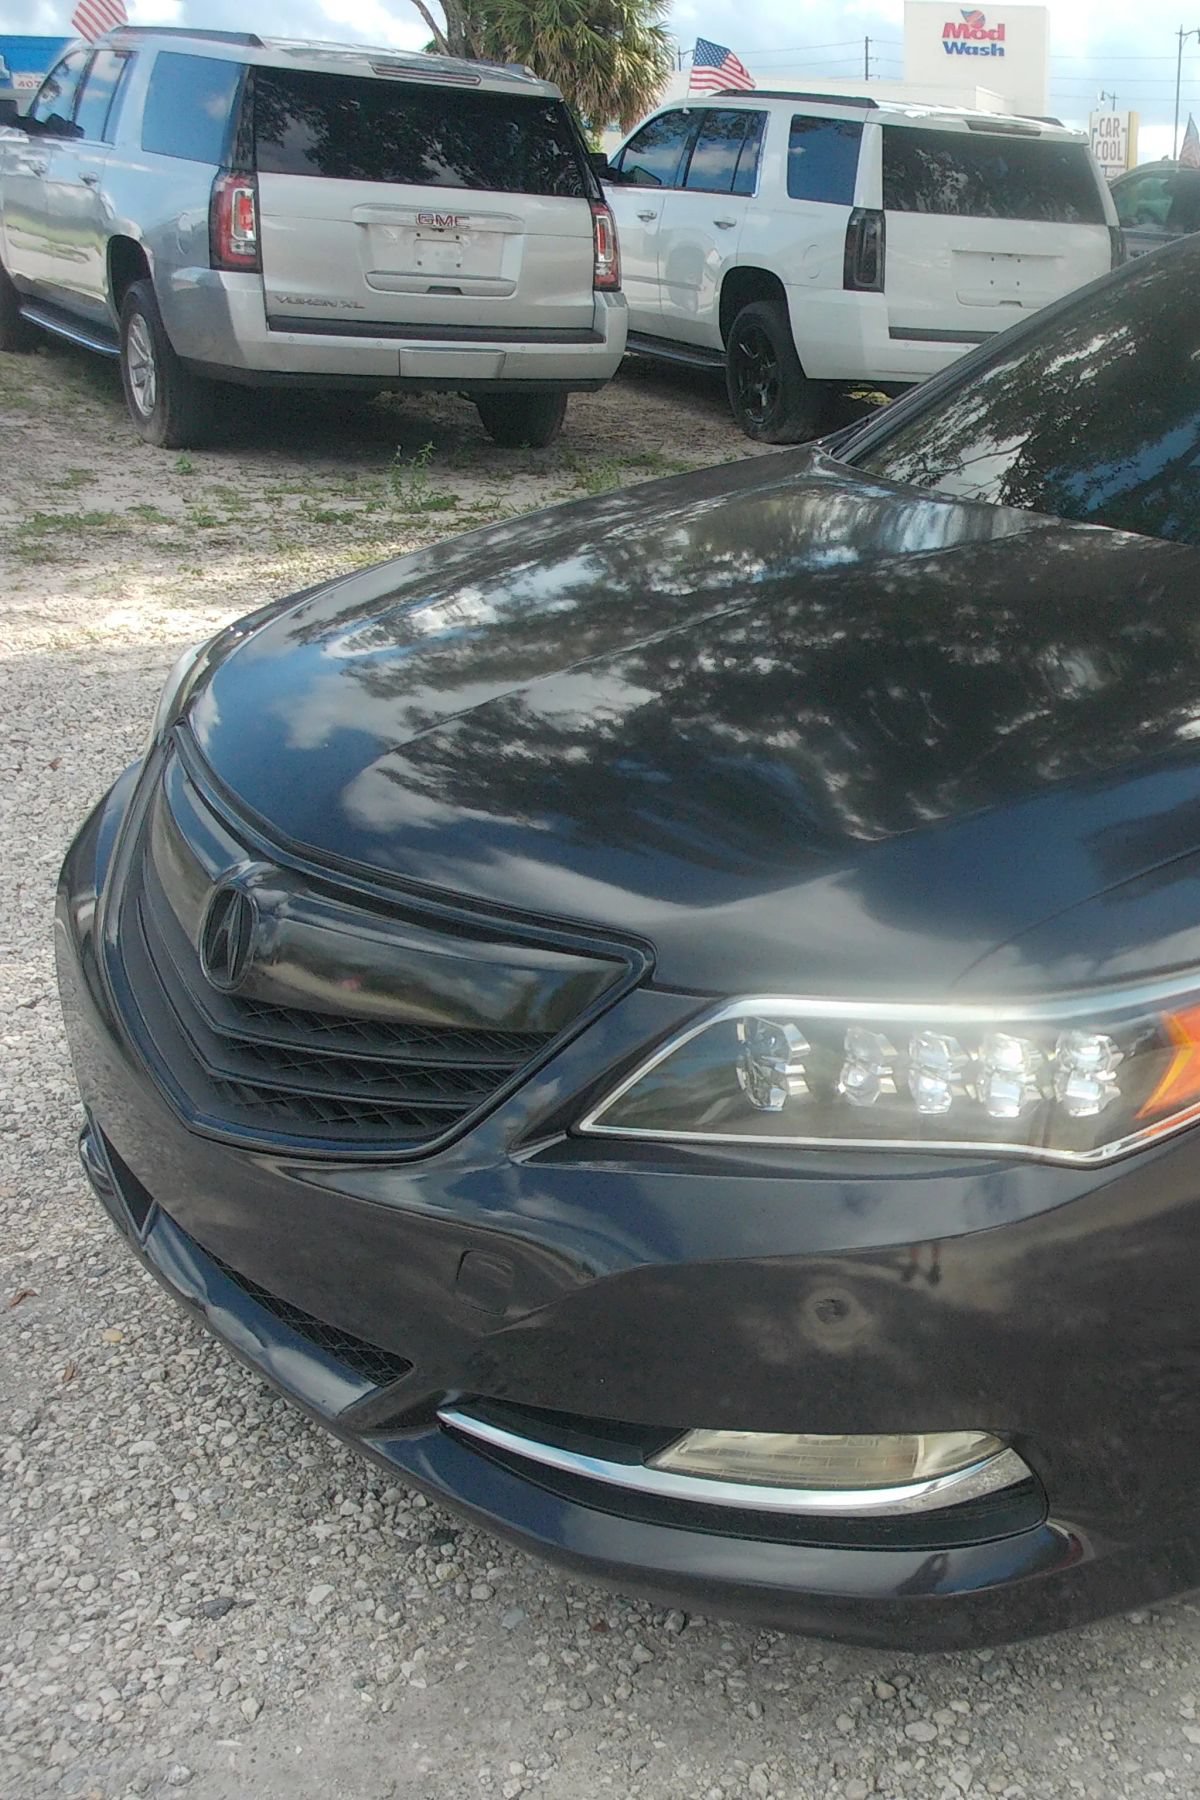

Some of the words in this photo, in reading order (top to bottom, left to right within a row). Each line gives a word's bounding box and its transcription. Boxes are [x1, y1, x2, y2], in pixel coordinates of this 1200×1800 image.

[942, 22, 1005, 41] Mod
[942, 40, 1005, 57] Wash
[1099, 117, 1121, 138] CAR
[1095, 140, 1123, 161] COOL
[416, 212, 471, 230] GMC
